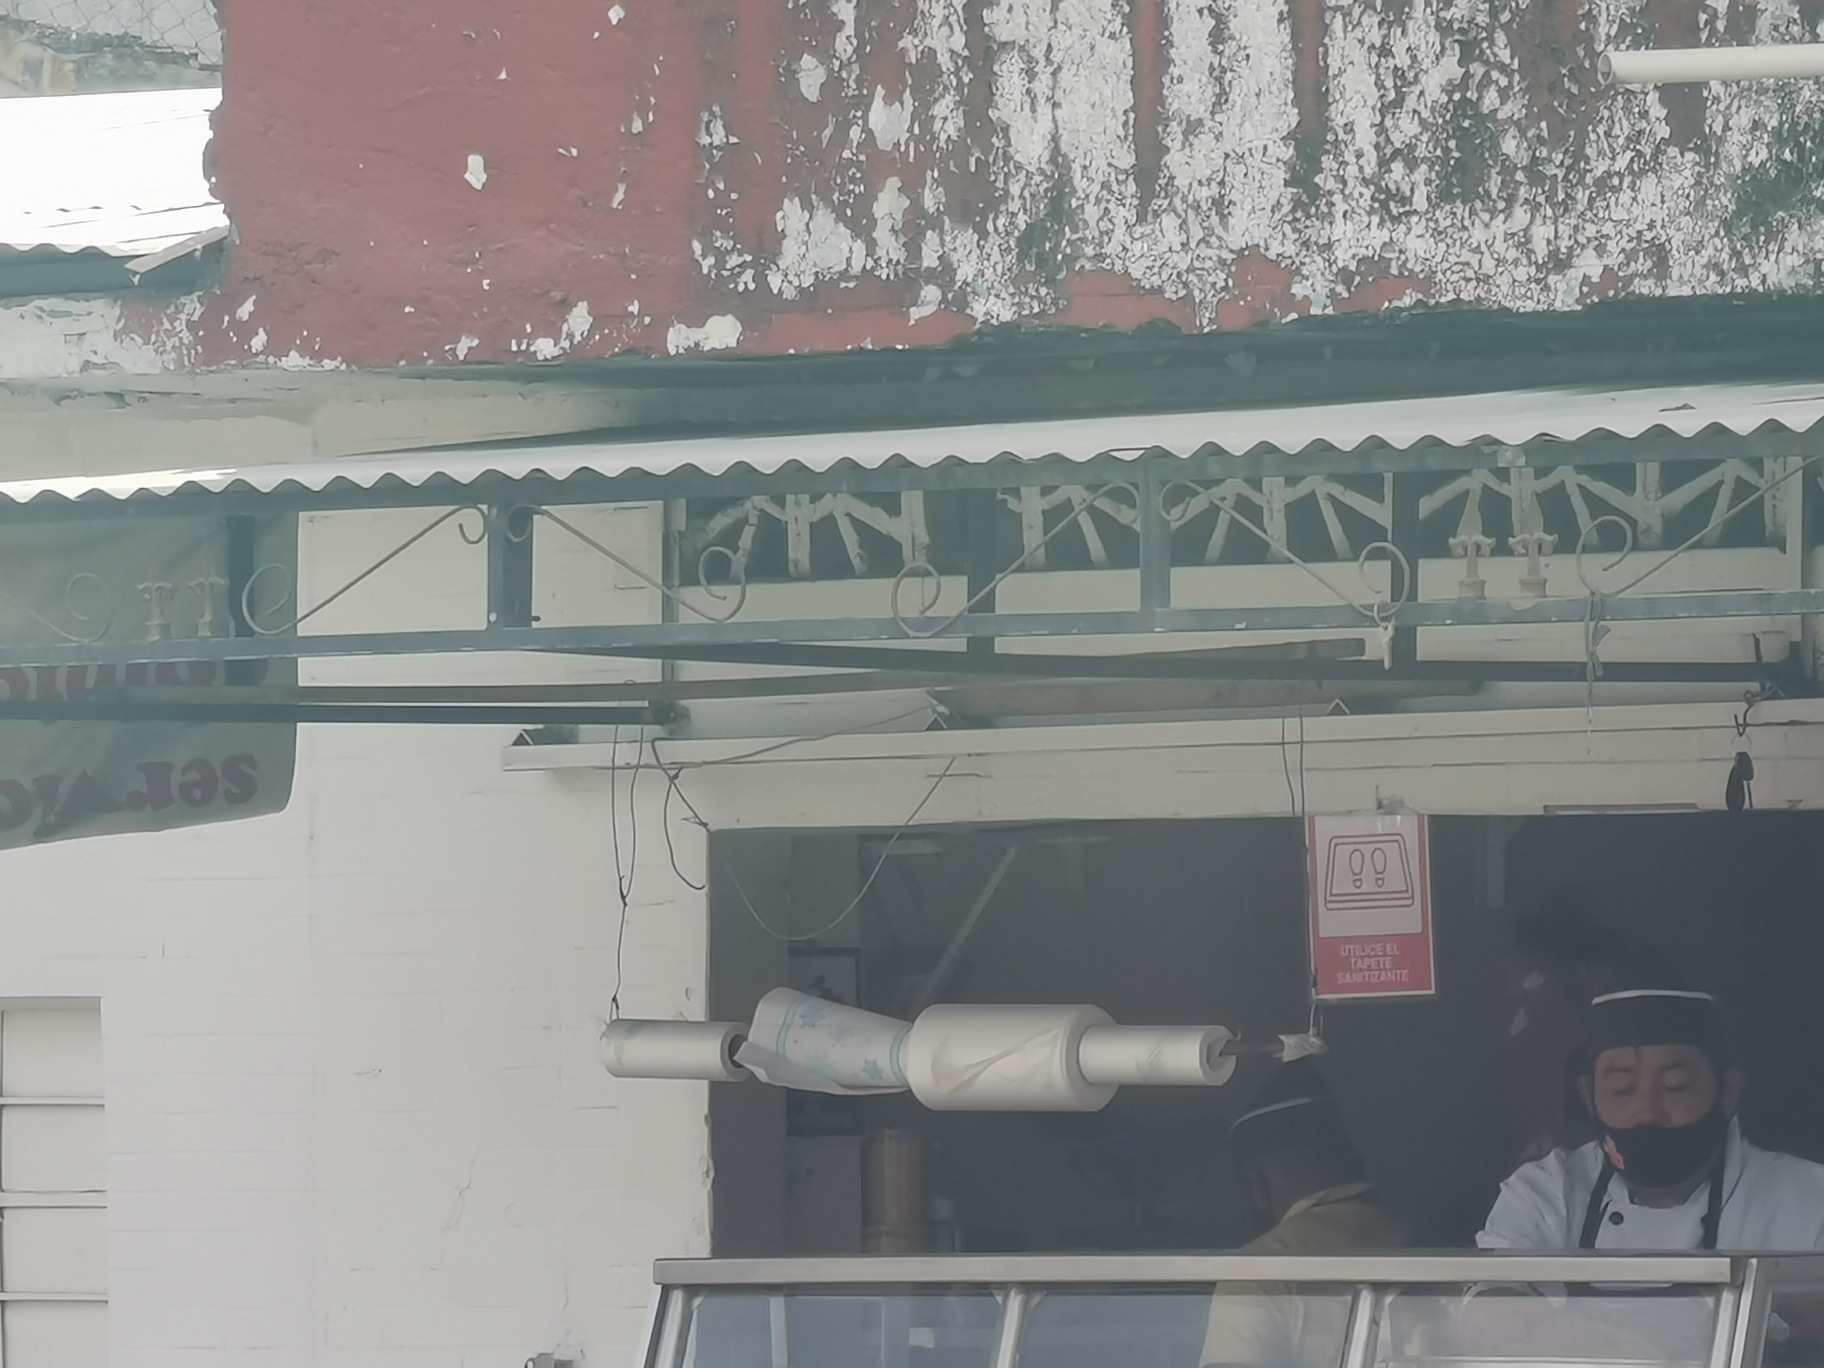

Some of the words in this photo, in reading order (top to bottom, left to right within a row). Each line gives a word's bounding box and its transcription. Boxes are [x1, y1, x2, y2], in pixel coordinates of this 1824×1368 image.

[1341, 942, 1384, 957] UTILICE
[1386, 942, 1401, 956] EL
[1350, 957, 1392, 970] TAPETE
[1337, 970, 1408, 984] SANITIZANTE
